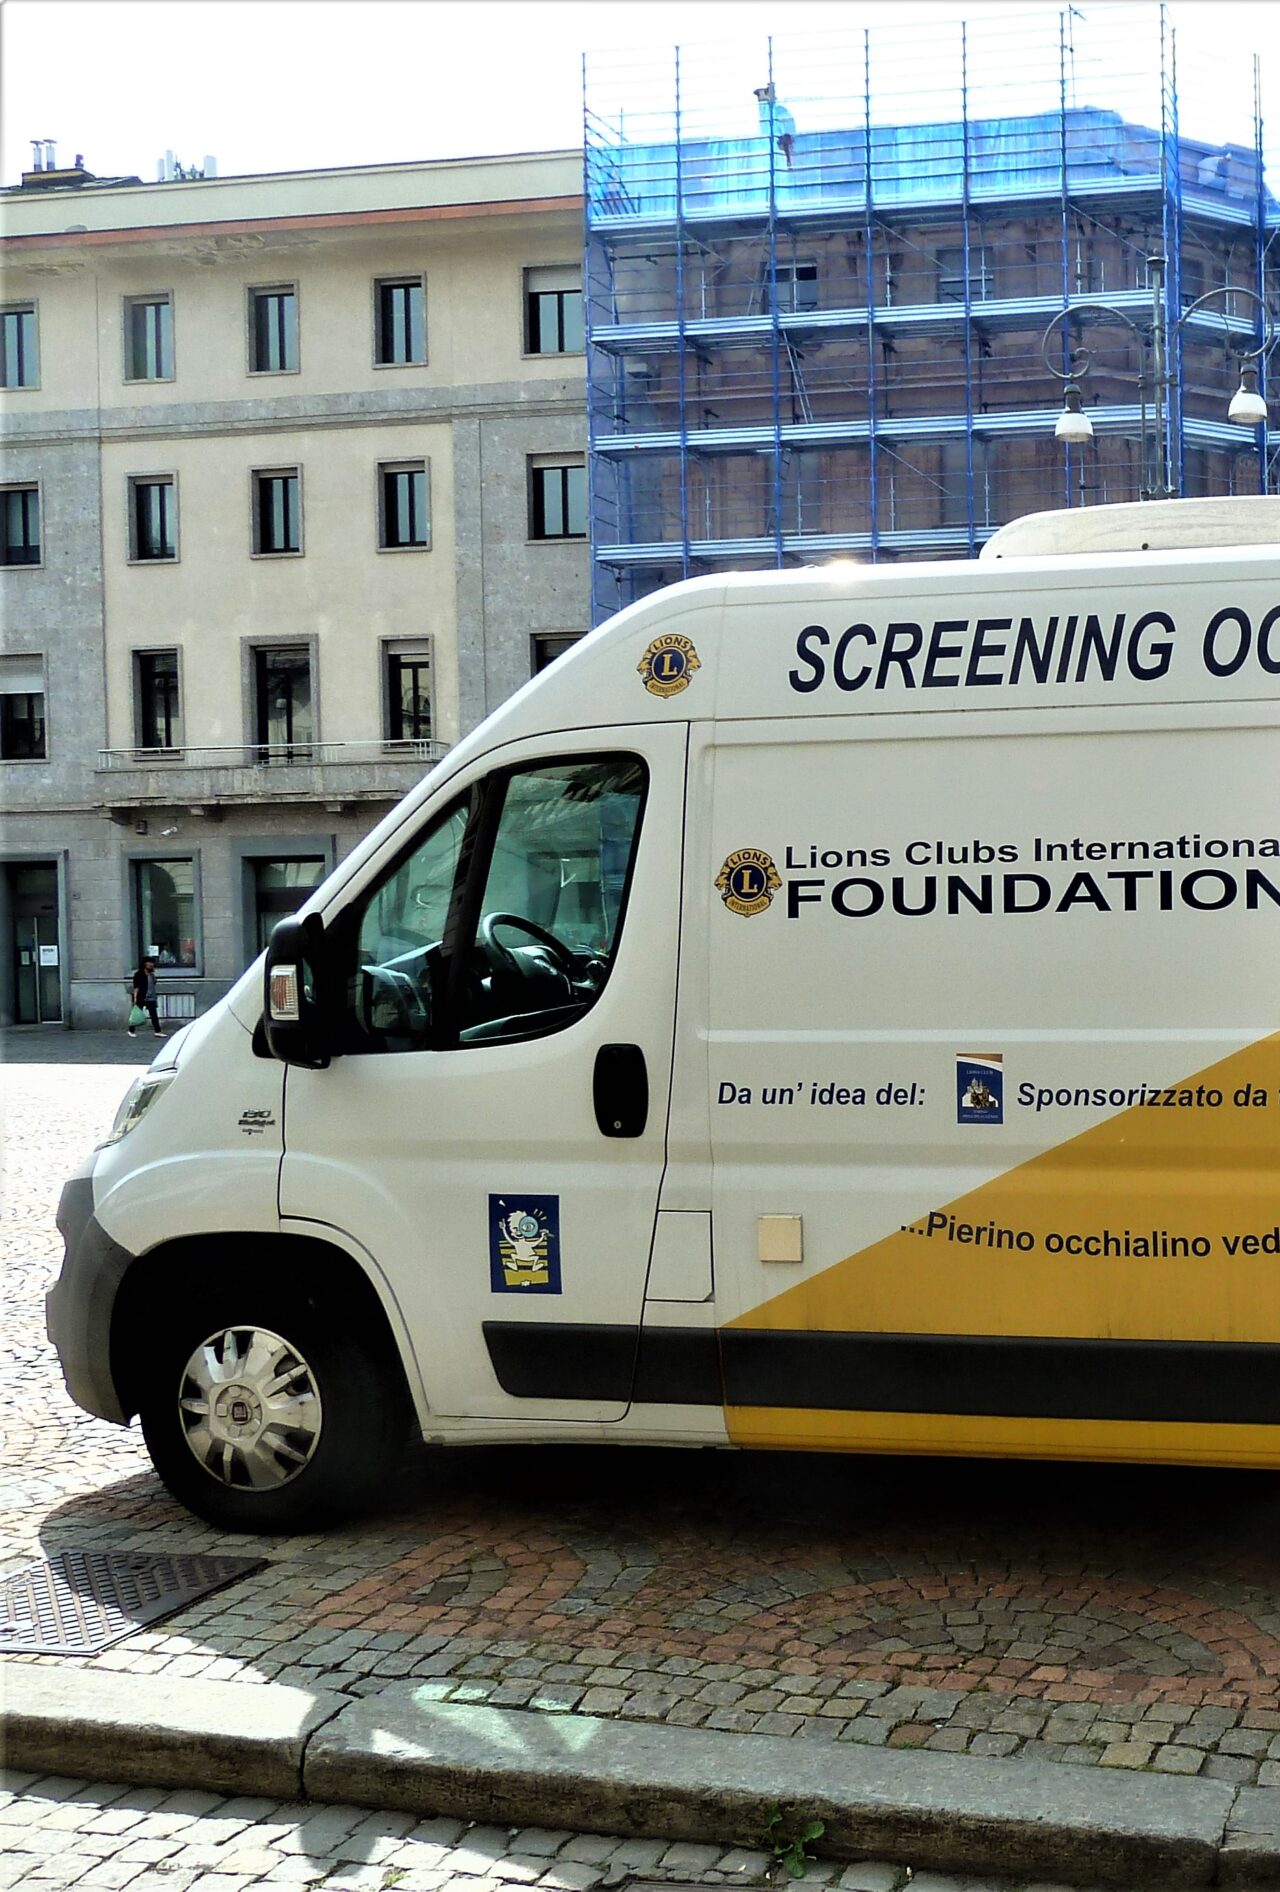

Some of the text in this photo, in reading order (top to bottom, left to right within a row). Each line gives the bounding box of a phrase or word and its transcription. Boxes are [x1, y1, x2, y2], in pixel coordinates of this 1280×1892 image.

[653, 636, 689, 651] LIONS
[788, 611, 1176, 693] SCREENING
[661, 653, 678, 676] L
[730, 851, 769, 866] LIONS
[785, 846, 891, 869] Lions
[905, 839, 1019, 866] Clubs
[741, 870, 758, 893] L
[718, 1082, 752, 1105] Da
[810, 1082, 866, 1106] idea
[875, 1082, 926, 1106] del:
[1017, 1082, 1223, 1112] Sponsorizzato
[1233, 1083, 1268, 1107] da
[900, 1211, 1035, 1252] ...Pierino
[1045, 1230, 1211, 1258] occhialino
